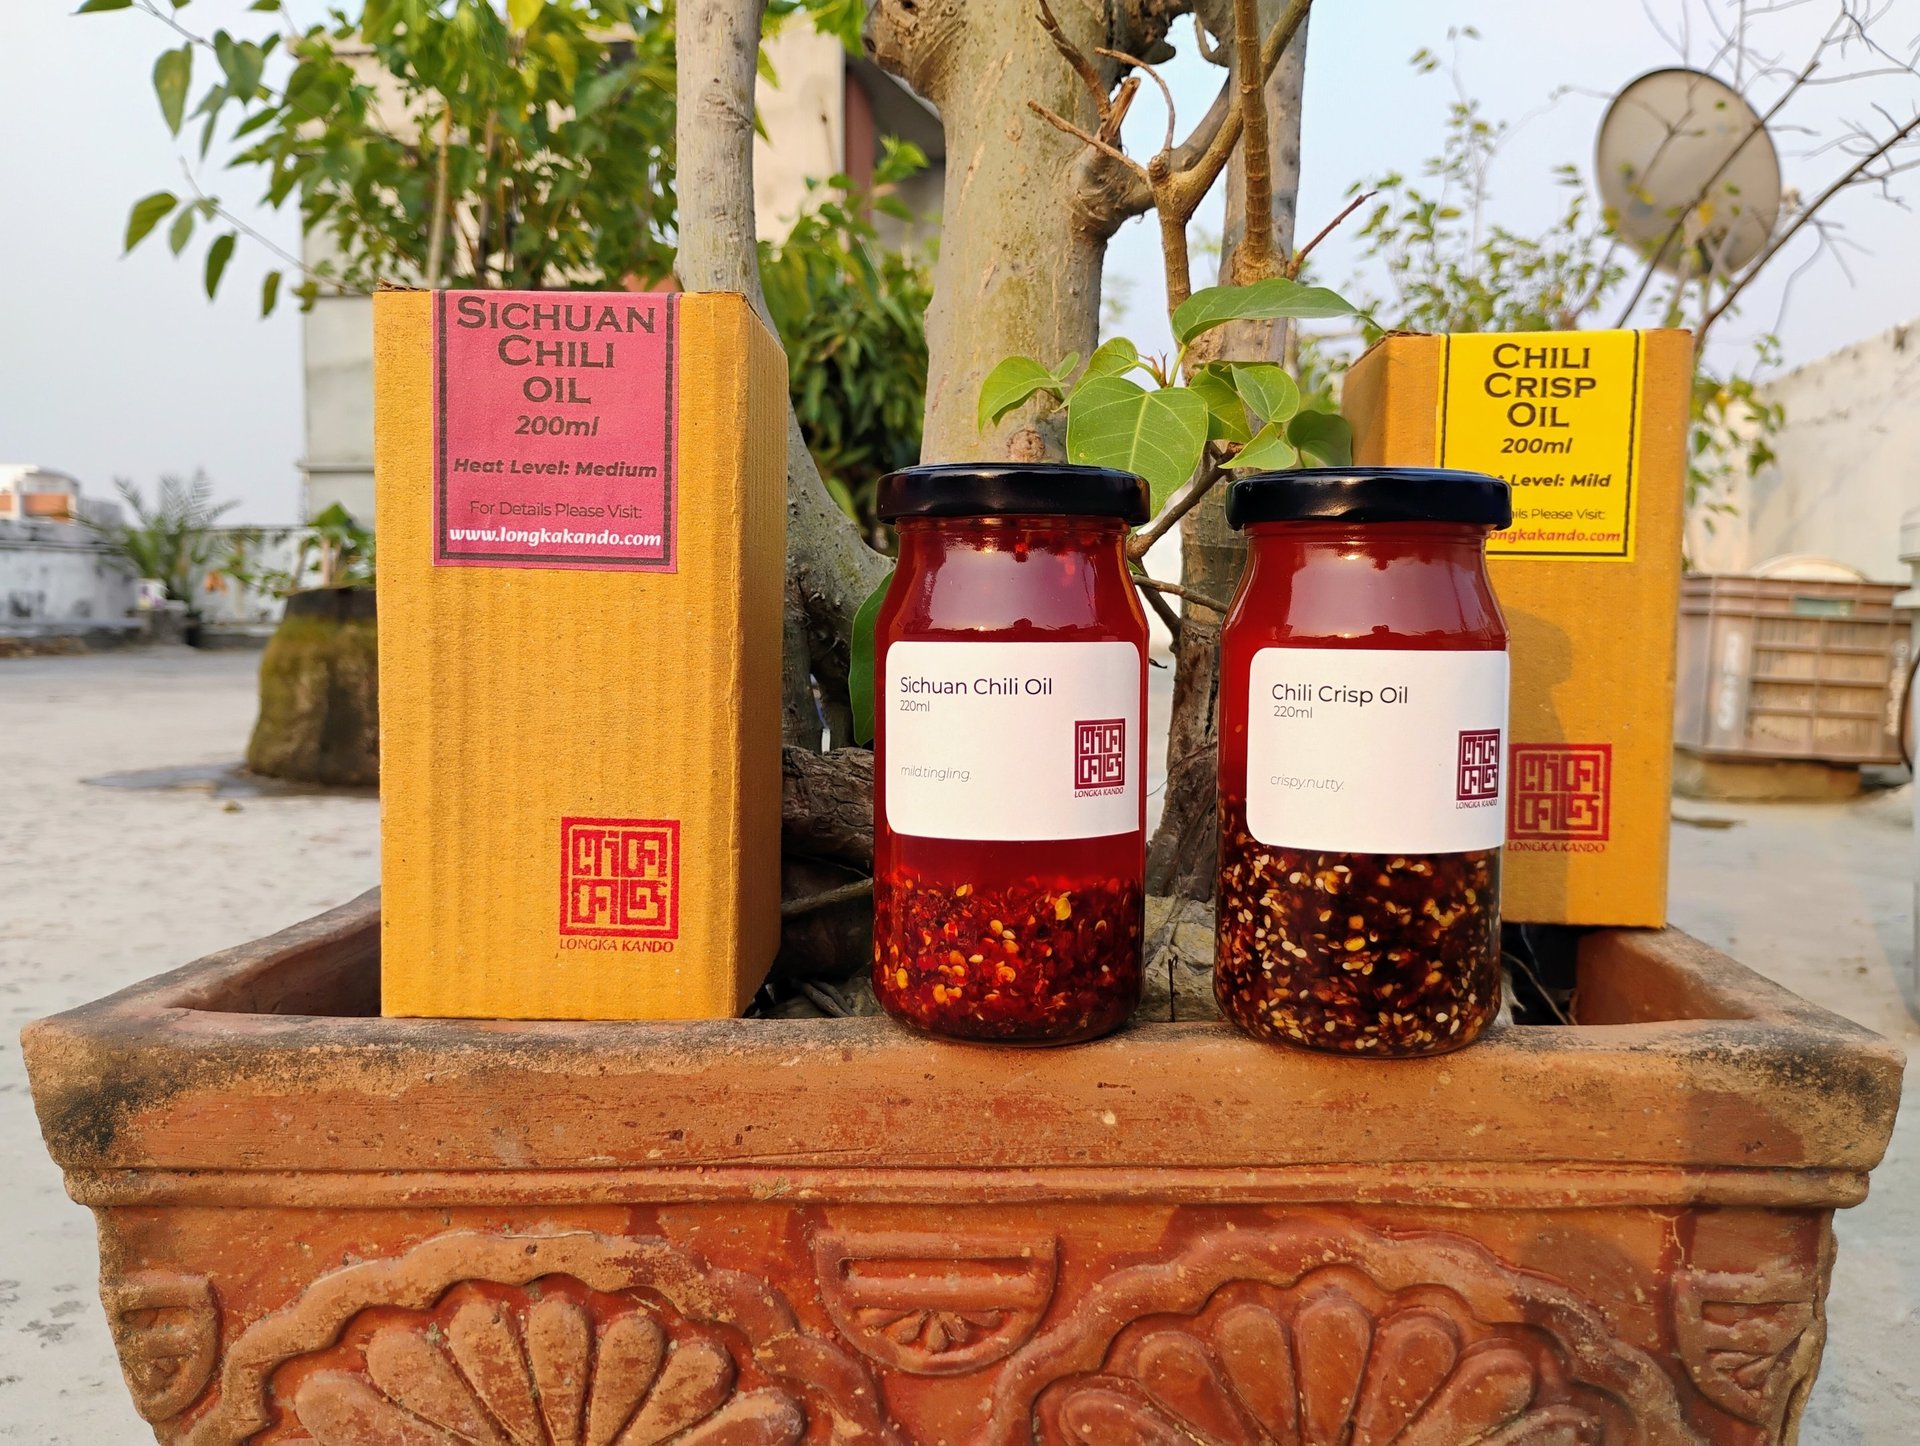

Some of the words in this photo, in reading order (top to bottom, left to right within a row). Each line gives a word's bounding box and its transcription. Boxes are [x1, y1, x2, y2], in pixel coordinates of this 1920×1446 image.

[457, 296, 656, 333] SICHUAN
[498, 334, 615, 368] CHILI
[1492, 343, 1590, 369] CHILI
[523, 376, 592, 404] OIL
[1484, 372, 1597, 398] CRISP
[1507, 402, 1570, 428] OIL
[514, 415, 601, 437] 200ml
[1501, 437, 1573, 454] 200ml
[453, 458, 504, 474] Heat
[510, 459, 570, 476] Level:
[575, 461, 658, 478] Medium
[1510, 474, 1565, 487] Level:
[1570, 473, 1612, 487] Mild
[470, 501, 495, 514] For
[500, 501, 552, 516] Details
[555, 503, 605, 518] Please
[607, 504, 643, 519] Visit:
[1531, 508, 1573, 520] Please
[1575, 508, 1606, 520] Visit:
[449, 526, 662, 547] www.longkakando.com
[900, 676, 967, 695] Sichuan
[973, 677, 1019, 696] Chili
[1024, 677, 1053, 696] Oil
[1271, 683, 1313, 702] Chili
[1318, 684, 1374, 707] Crisp
[1379, 686, 1409, 704] Oil
[899, 700, 931, 713] 220ml
[1273, 705, 1313, 719] 220ml
[1074, 789, 1102, 798] LONGKA
[1103, 787, 1124, 796] KANDO
[1455, 800, 1481, 810] LONGKA
[1481, 799, 1497, 808] KANDO
[1508, 841, 1557, 852] LONGKA
[1560, 842, 1606, 853] KANDO
[559, 938, 618, 951] LONGKA
[621, 940, 674, 953] KANDO
